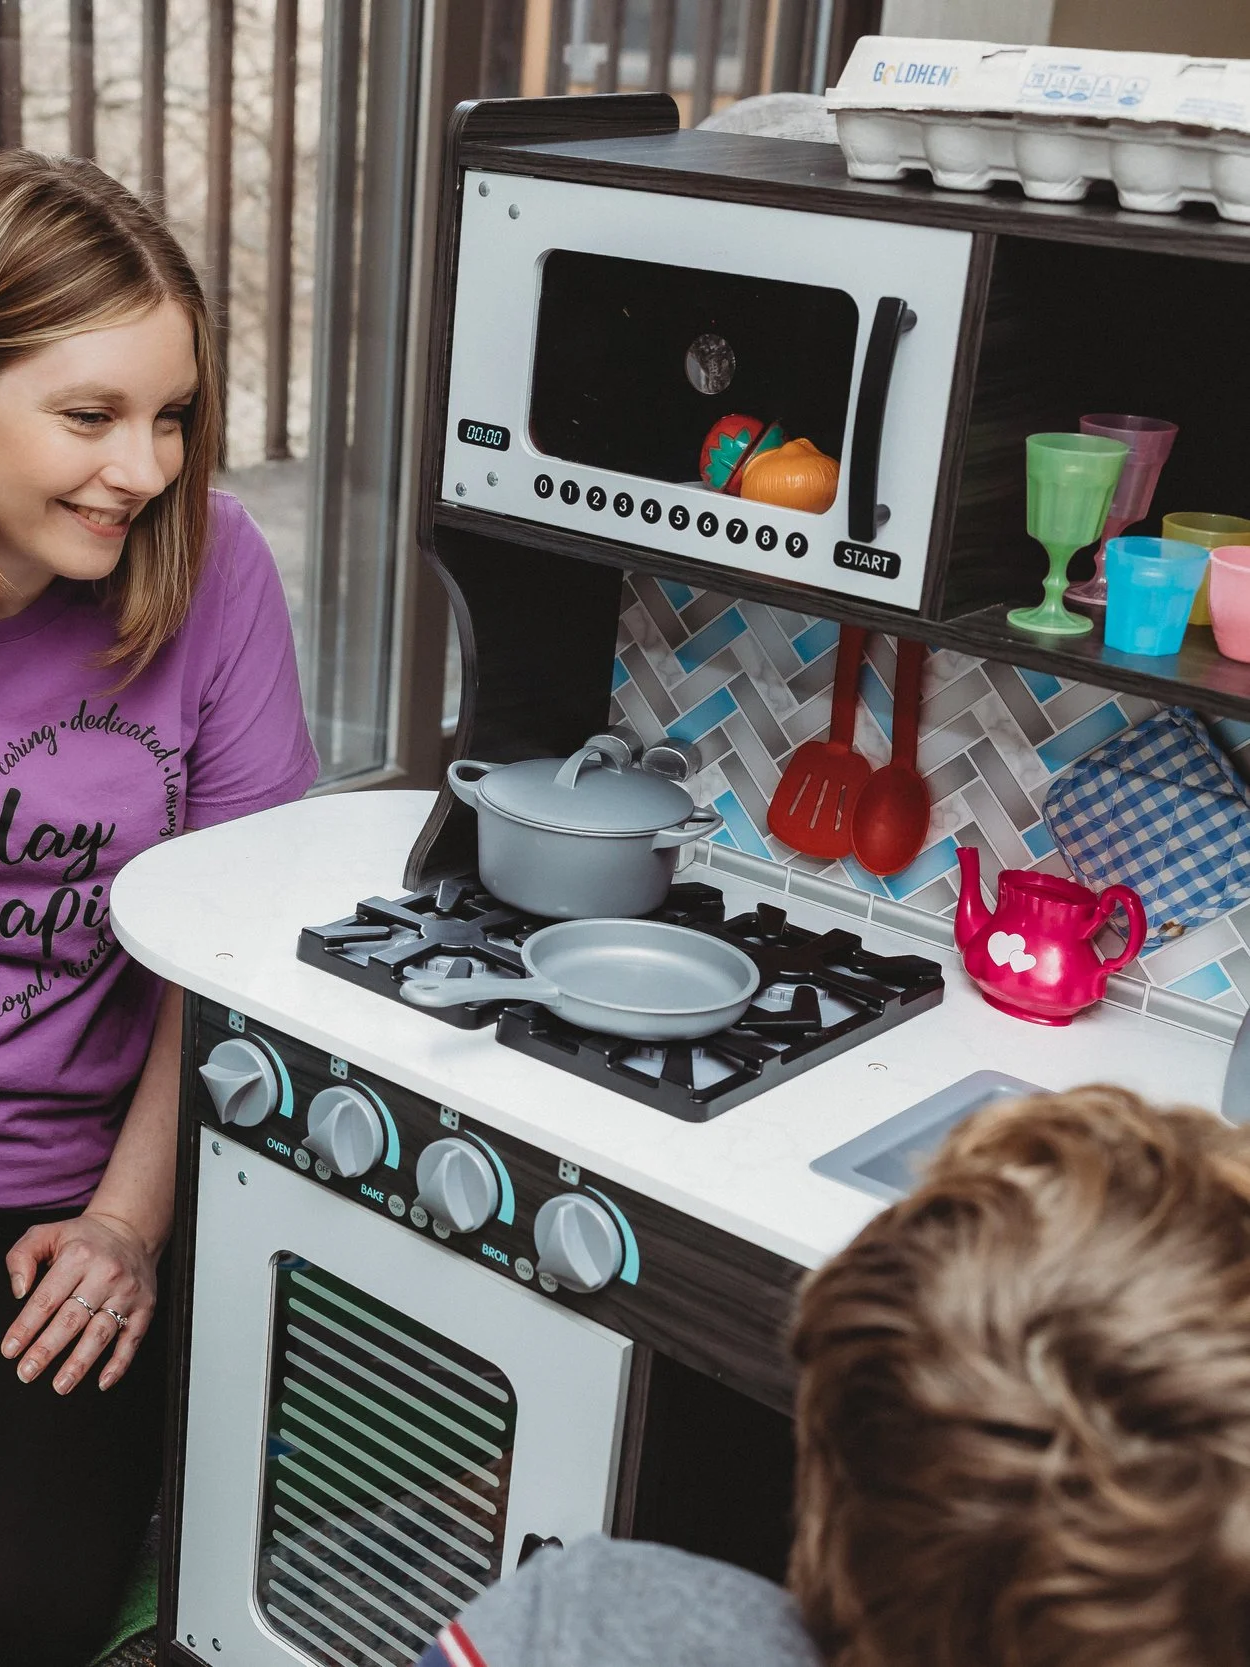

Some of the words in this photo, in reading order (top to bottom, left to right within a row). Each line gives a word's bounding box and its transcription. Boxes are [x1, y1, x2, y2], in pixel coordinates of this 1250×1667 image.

[466, 425, 502, 446] 00:00
[539, 479, 548, 493] 0
[567, 485, 572, 499] 1
[592, 492, 601, 506] 2
[619, 498, 627, 512] 3
[645, 504, 654, 518] 4
[674, 511, 683, 524] 5
[703, 517, 711, 532] 6
[733, 523, 742, 538] 7
[761, 531, 770, 545] 8
[792, 537, 801, 552] 9
[843, 548, 891, 573] START
[70, 699, 180, 767] dedicated
[62, 927, 111, 978] kind
[266, 1137, 291, 1157] OVEN
[296, 1153, 308, 1165] ON
[316, 1163, 329, 1175] OFF
[360, 1183, 385, 1204] BAKE
[481, 1243, 510, 1267] BROIL
[516, 1262, 532, 1276] LOW
